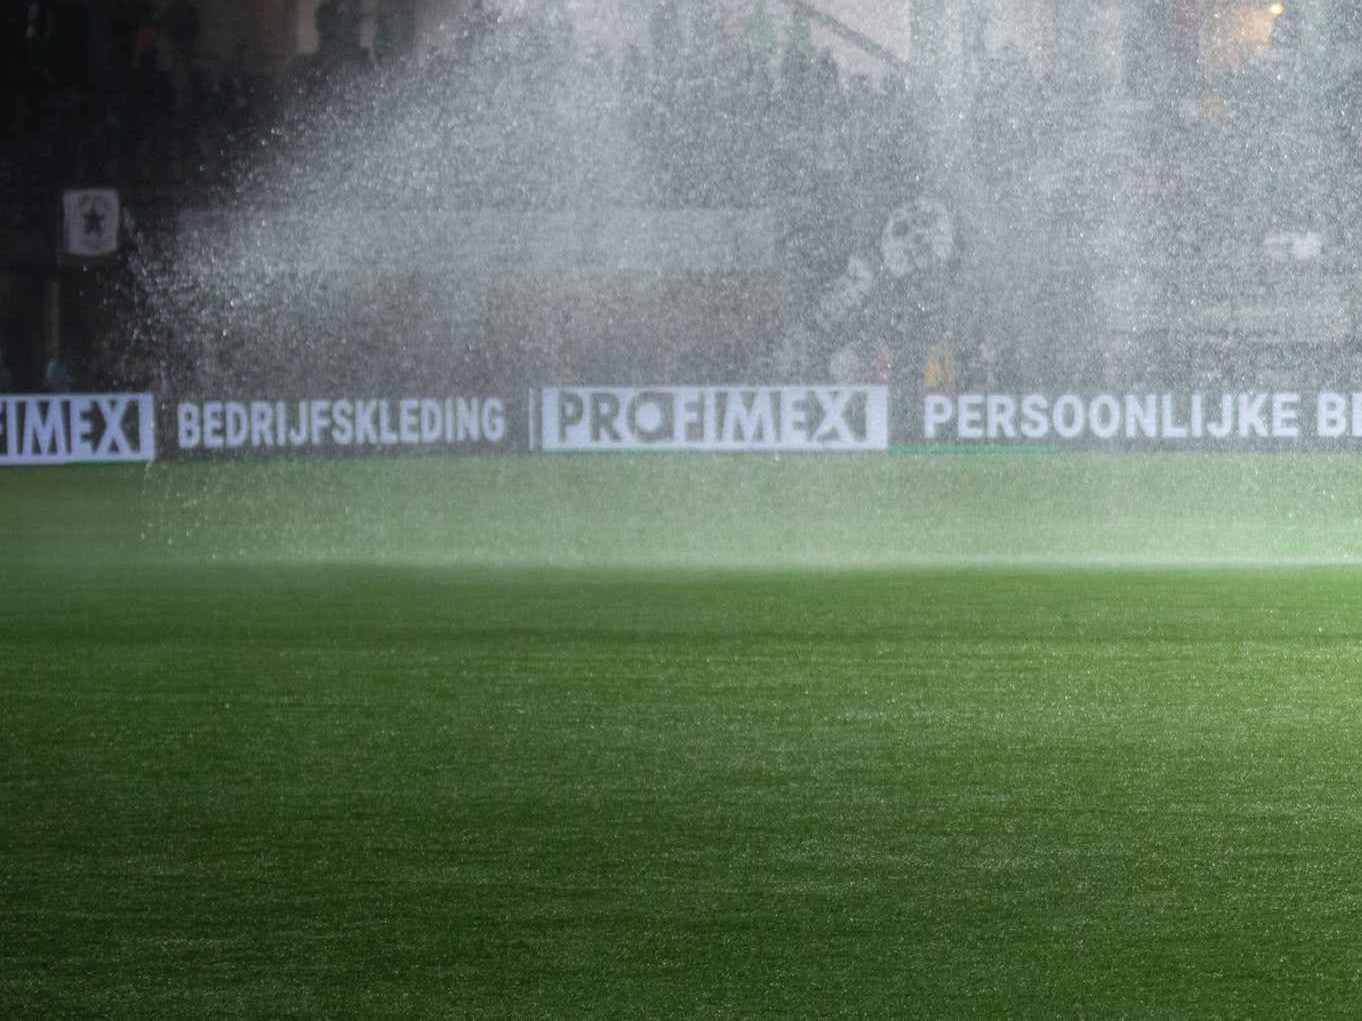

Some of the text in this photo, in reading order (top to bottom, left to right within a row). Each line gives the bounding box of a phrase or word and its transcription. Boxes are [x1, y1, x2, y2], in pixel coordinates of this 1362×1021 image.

[176, 396, 506, 450] BEDRIJFSKLEDING
[557, 389, 855, 442] PROFIMEX
[923, 392, 1300, 440] PERSOONLIJKE
